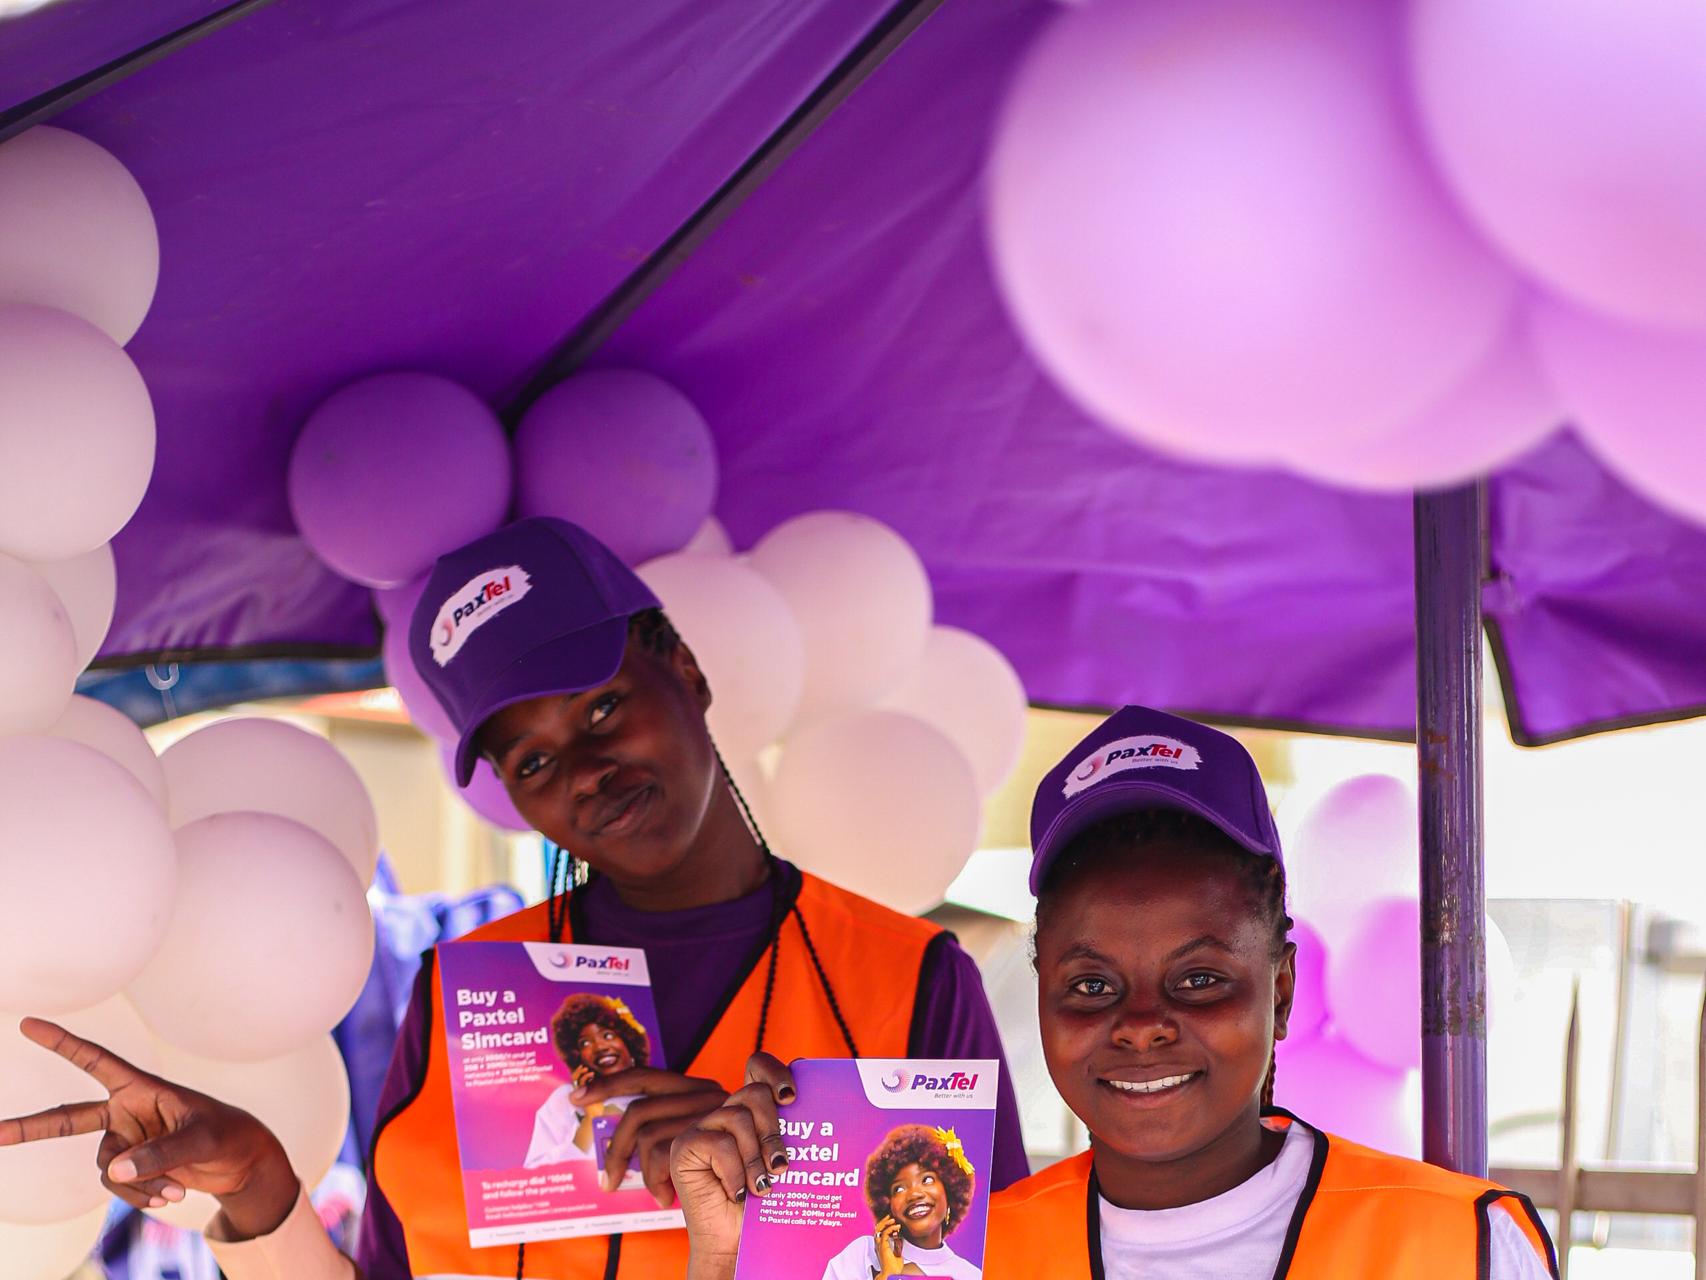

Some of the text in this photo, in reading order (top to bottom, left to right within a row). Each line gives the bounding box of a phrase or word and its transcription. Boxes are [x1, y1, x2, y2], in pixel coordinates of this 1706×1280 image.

[453, 576, 511, 627] PaxTel
[1105, 743, 1183, 766] PaxTel
[575, 956, 629, 971] PaxTel
[457, 989, 516, 1007] Buy a
[459, 1007, 525, 1028] Paxtel
[461, 1027, 549, 1050] Simcard
[911, 1072, 979, 1090] PaxTel
[820, 1121, 834, 1136] a
[785, 1143, 839, 1161] axtel
